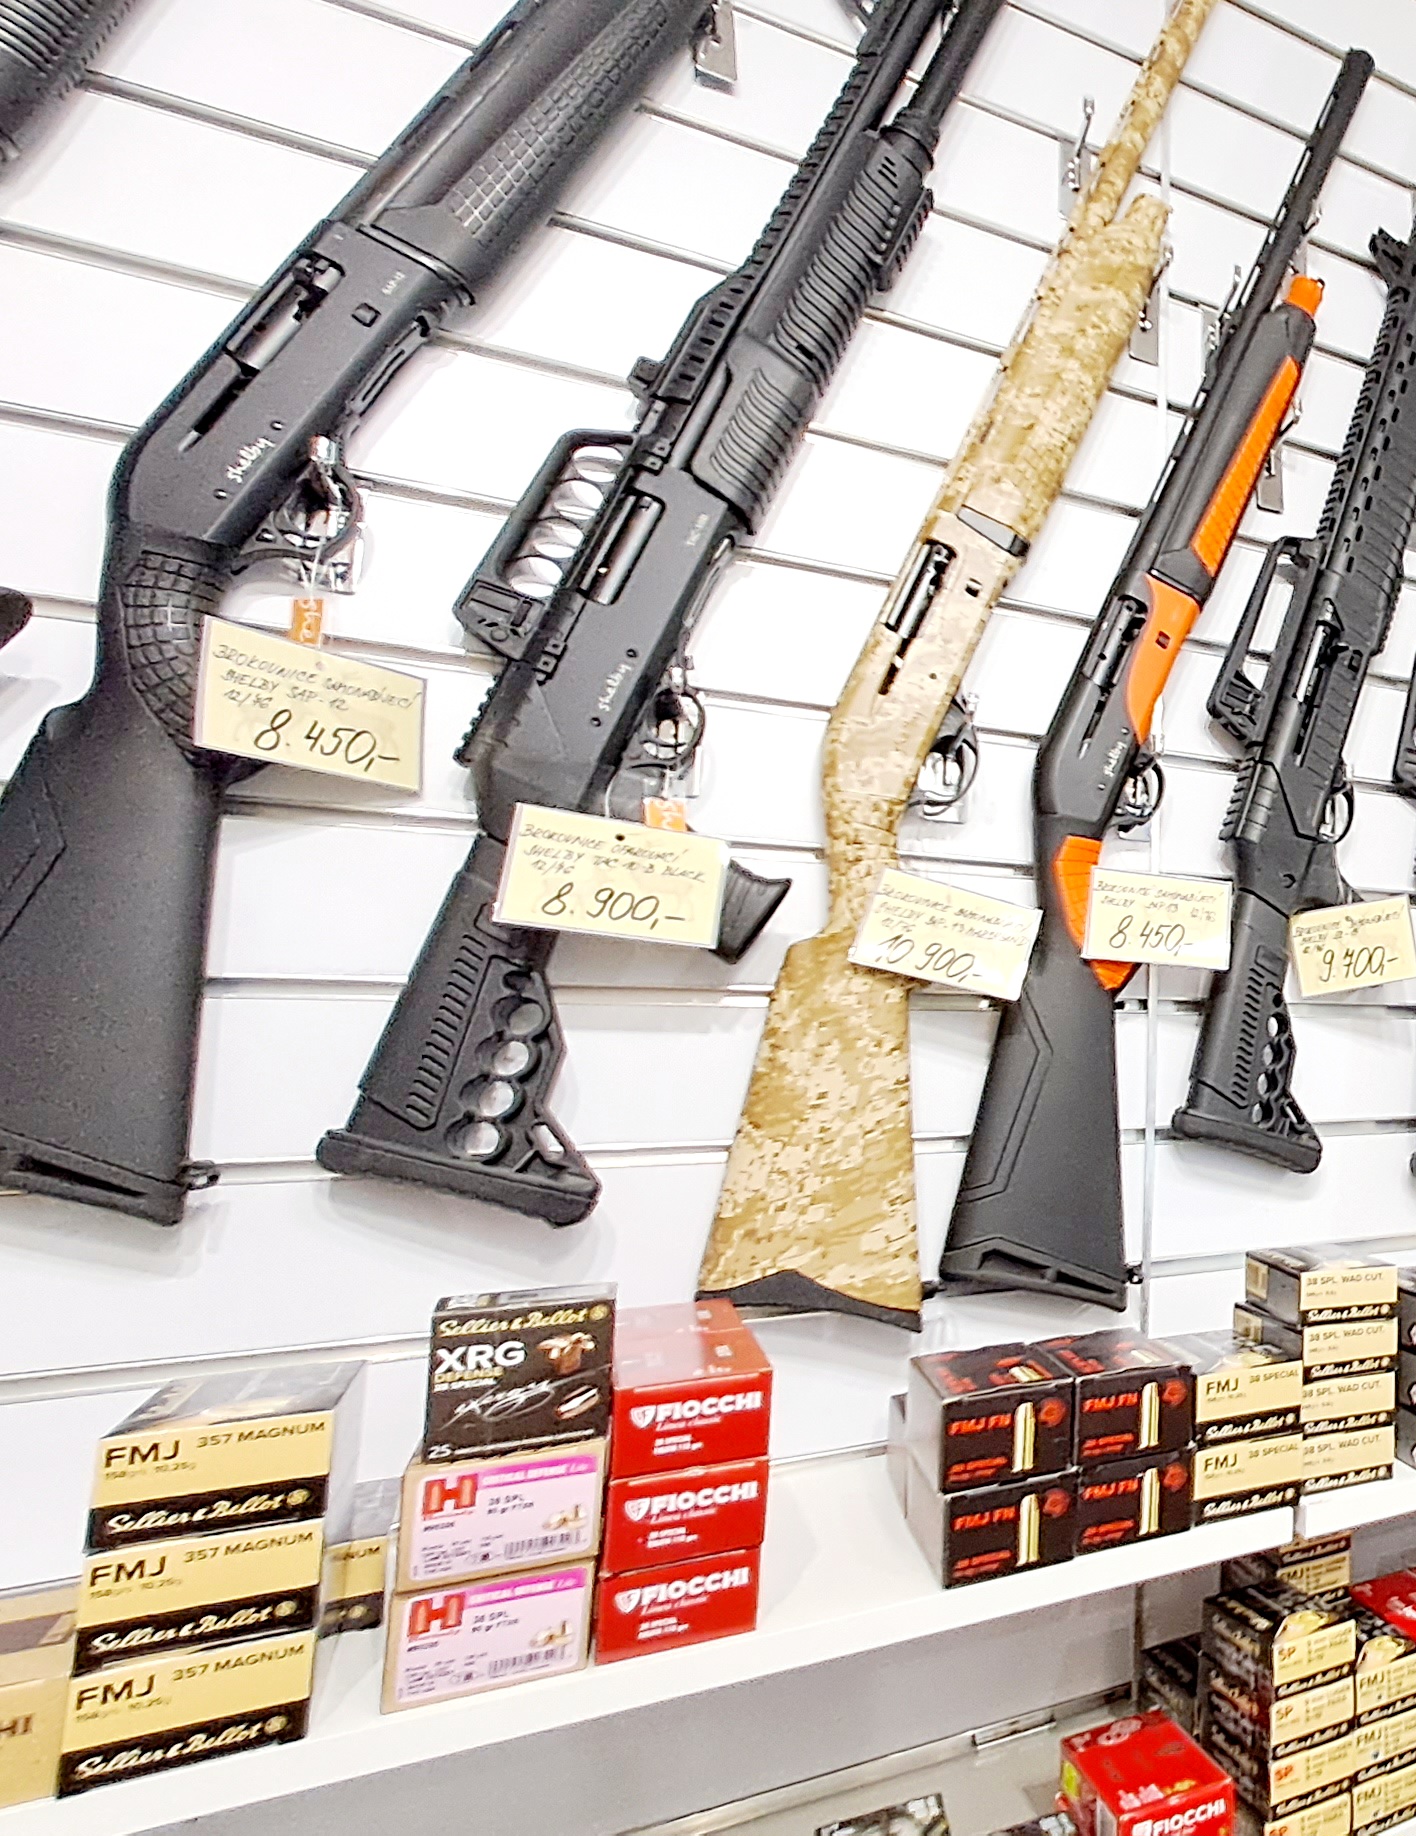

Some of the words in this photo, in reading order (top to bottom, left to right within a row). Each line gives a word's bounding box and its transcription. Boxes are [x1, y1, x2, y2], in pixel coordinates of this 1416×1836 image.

[435, 1340, 527, 1375] XRG
[1206, 1377, 1240, 1396] FMJ
[654, 1390, 764, 1424] FIOCCHI
[104, 1440, 180, 1469] FMJ
[196, 1432, 233, 1449] 357
[237, 1421, 325, 1443] MAGNUM
[1203, 1452, 1238, 1473] FMJ
[650, 1480, 760, 1516] FIOCCHI
[89, 1555, 168, 1588] FMJ
[183, 1547, 221, 1564] 357
[223, 1531, 313, 1556] MAGNUM
[640, 1566, 751, 1607] FIOCCHI
[75, 1674, 157, 1712] FMJ
[171, 1663, 209, 1682] 357
[213, 1644, 305, 1674] MAGNUM
[1359, 1673, 1386, 1690] FMJ
[1356, 1729, 1382, 1747] FMJ
[1356, 1783, 1382, 1803] FMJ
